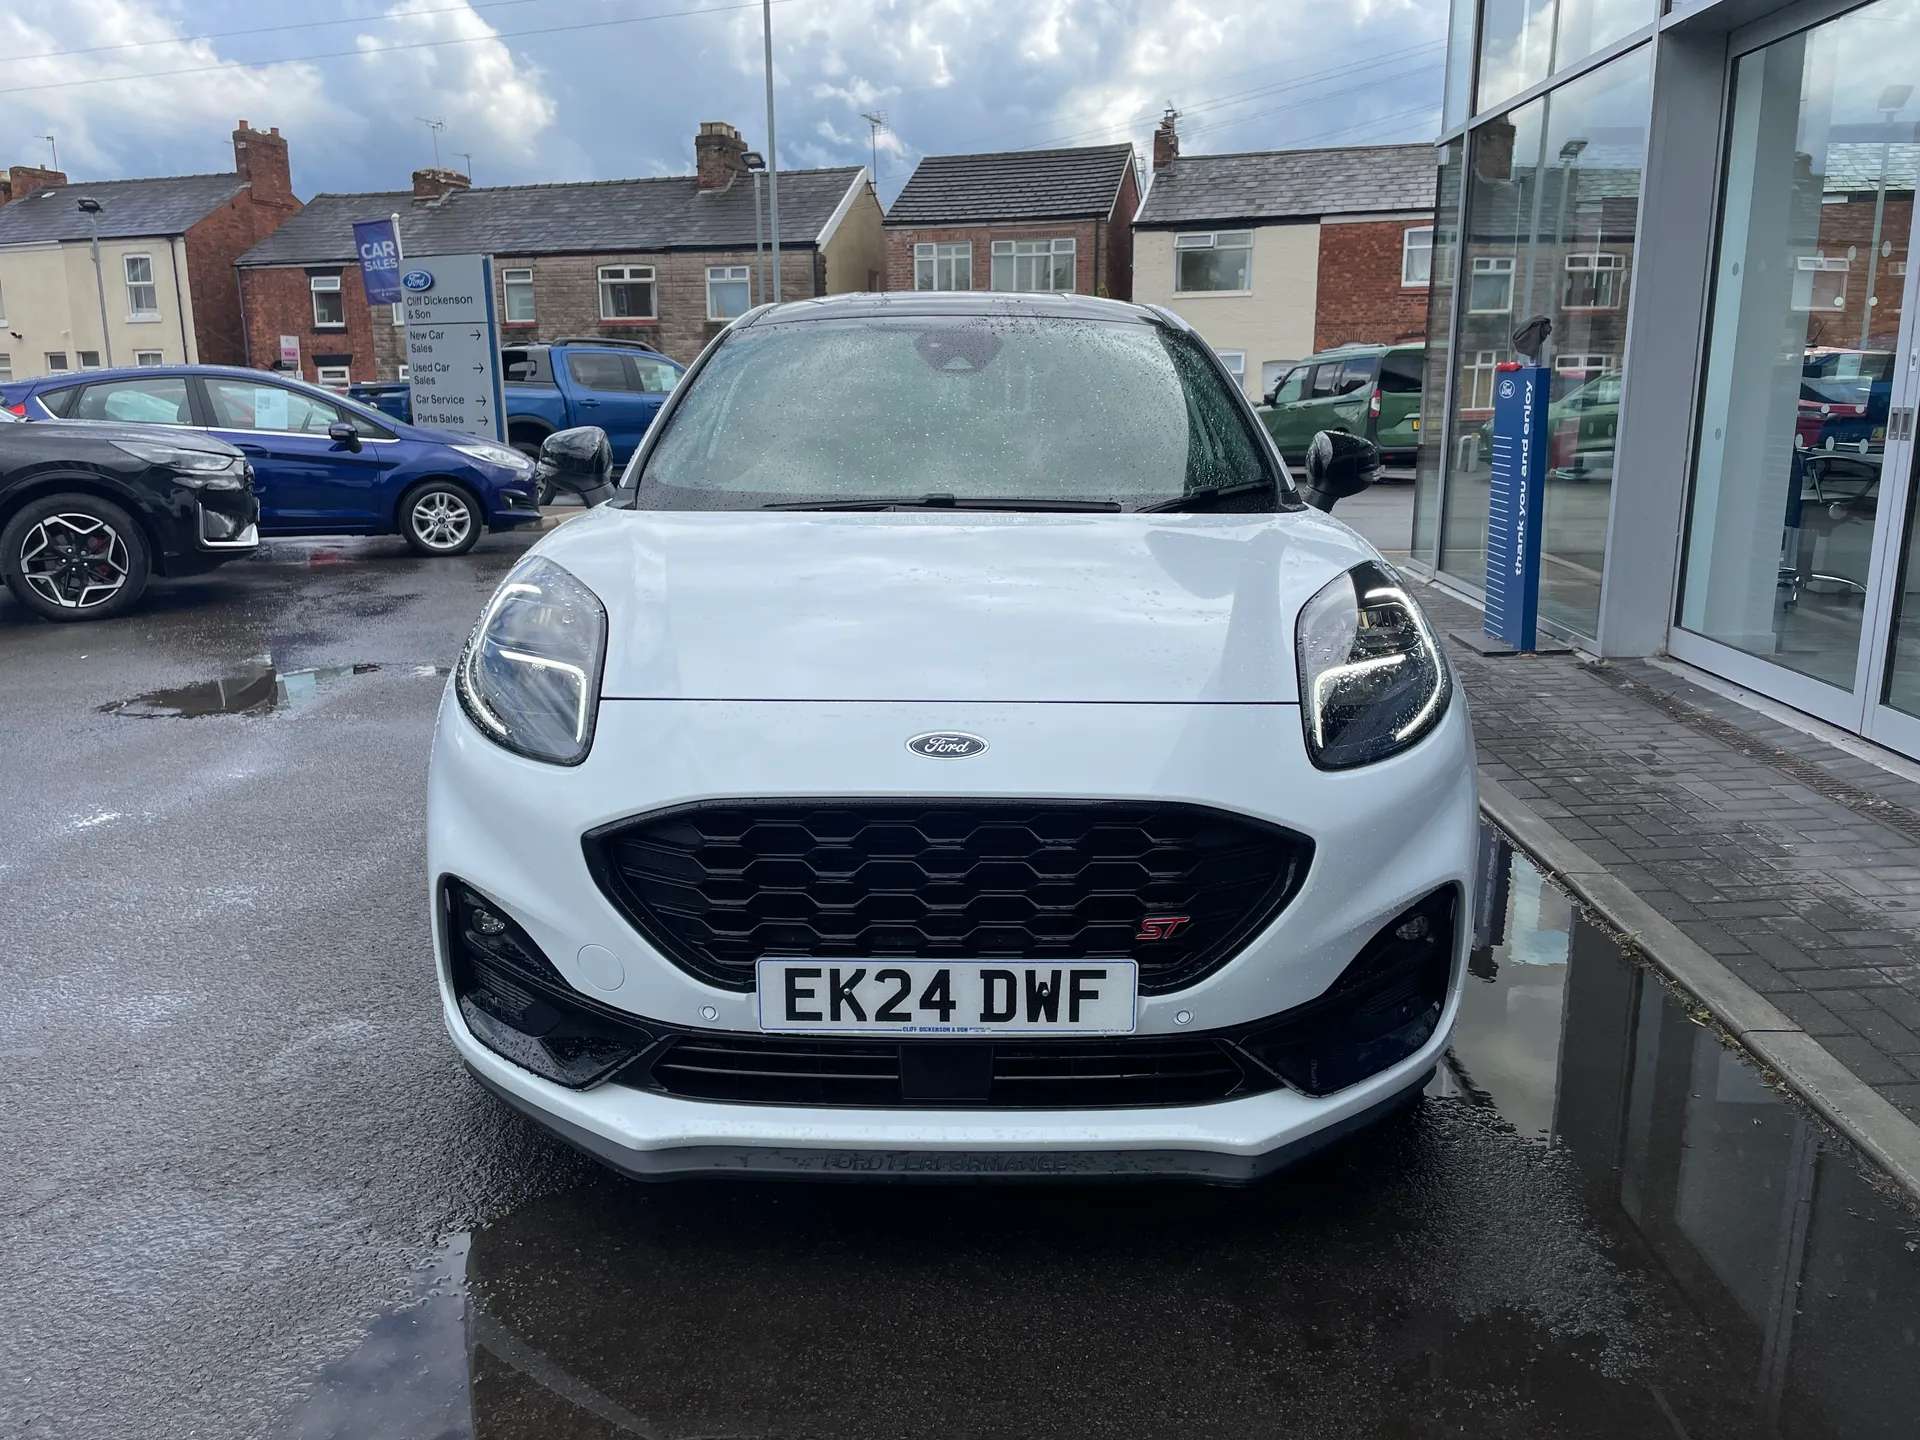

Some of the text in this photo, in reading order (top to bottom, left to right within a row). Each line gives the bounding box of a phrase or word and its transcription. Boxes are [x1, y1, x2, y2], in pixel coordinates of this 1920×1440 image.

[361, 240, 395, 260] CAR
[364, 258, 398, 272] SALES
[406, 295, 474, 307] Cliff Dickenson
[408, 309, 431, 320] & Son
[409, 329, 445, 341] New Car
[411, 343, 433, 353] Sales
[412, 361, 450, 373] Used Car
[414, 375, 436, 385] Sales
[415, 393, 465, 405] Car Service
[417, 413, 465, 424] Parts Sales
[1515, 379, 1533, 577] thank you and enjoy
[924, 736, 970, 753] Ford
[1136, 916, 1191, 940] ST
[784, 967, 1108, 1023] EK24 DWF
